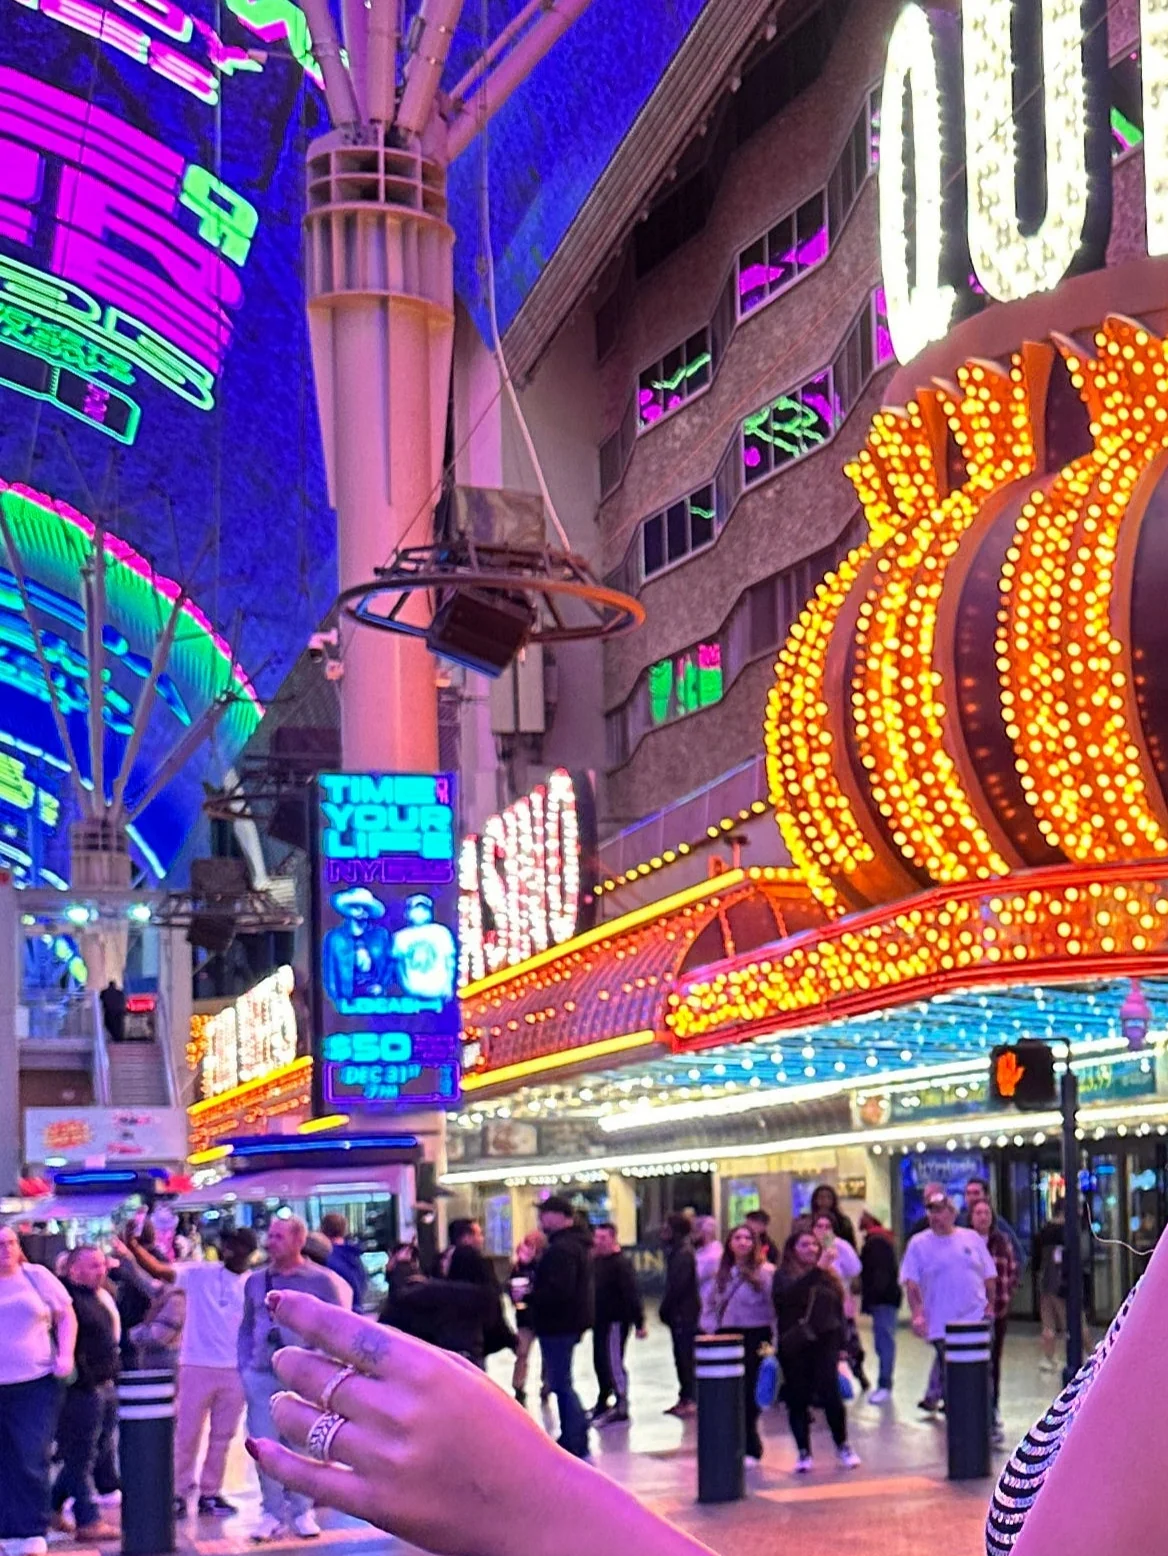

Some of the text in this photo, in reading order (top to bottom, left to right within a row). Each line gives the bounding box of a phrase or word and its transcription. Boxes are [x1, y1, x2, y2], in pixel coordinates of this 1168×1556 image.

[319, 774, 436, 804] TIME
[320, 803, 452, 832] YOUR
[323, 829, 453, 859] LIFE
[323, 1032, 412, 1062] $50
[340, 1065, 383, 1085] DEC
